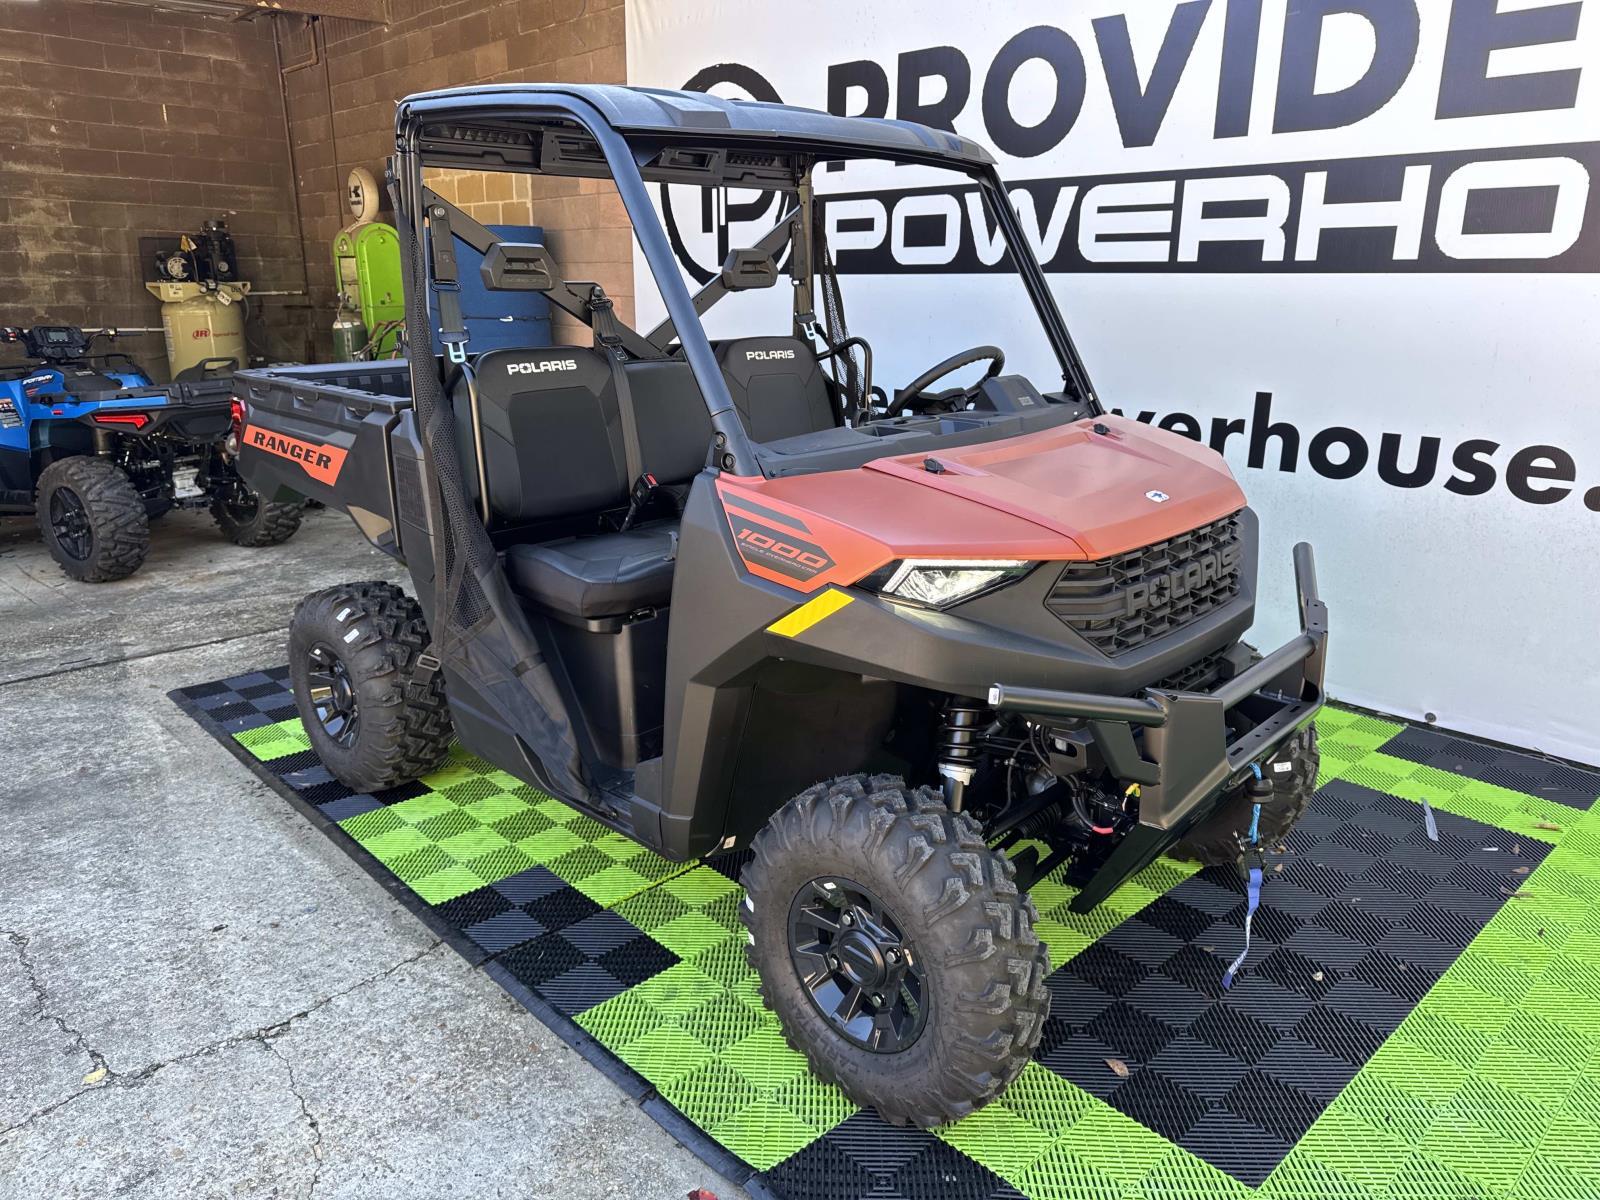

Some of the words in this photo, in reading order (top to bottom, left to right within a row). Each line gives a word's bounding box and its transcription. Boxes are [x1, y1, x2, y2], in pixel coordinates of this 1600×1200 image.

[824, 156, 1590, 266] POWERHO
[506, 359, 578, 376] POLARIS
[745, 349, 796, 361] POLARIS
[253, 431, 332, 470] RANGER
[738, 528, 828, 569] 1000
[1126, 548, 1238, 617] POLARIS
